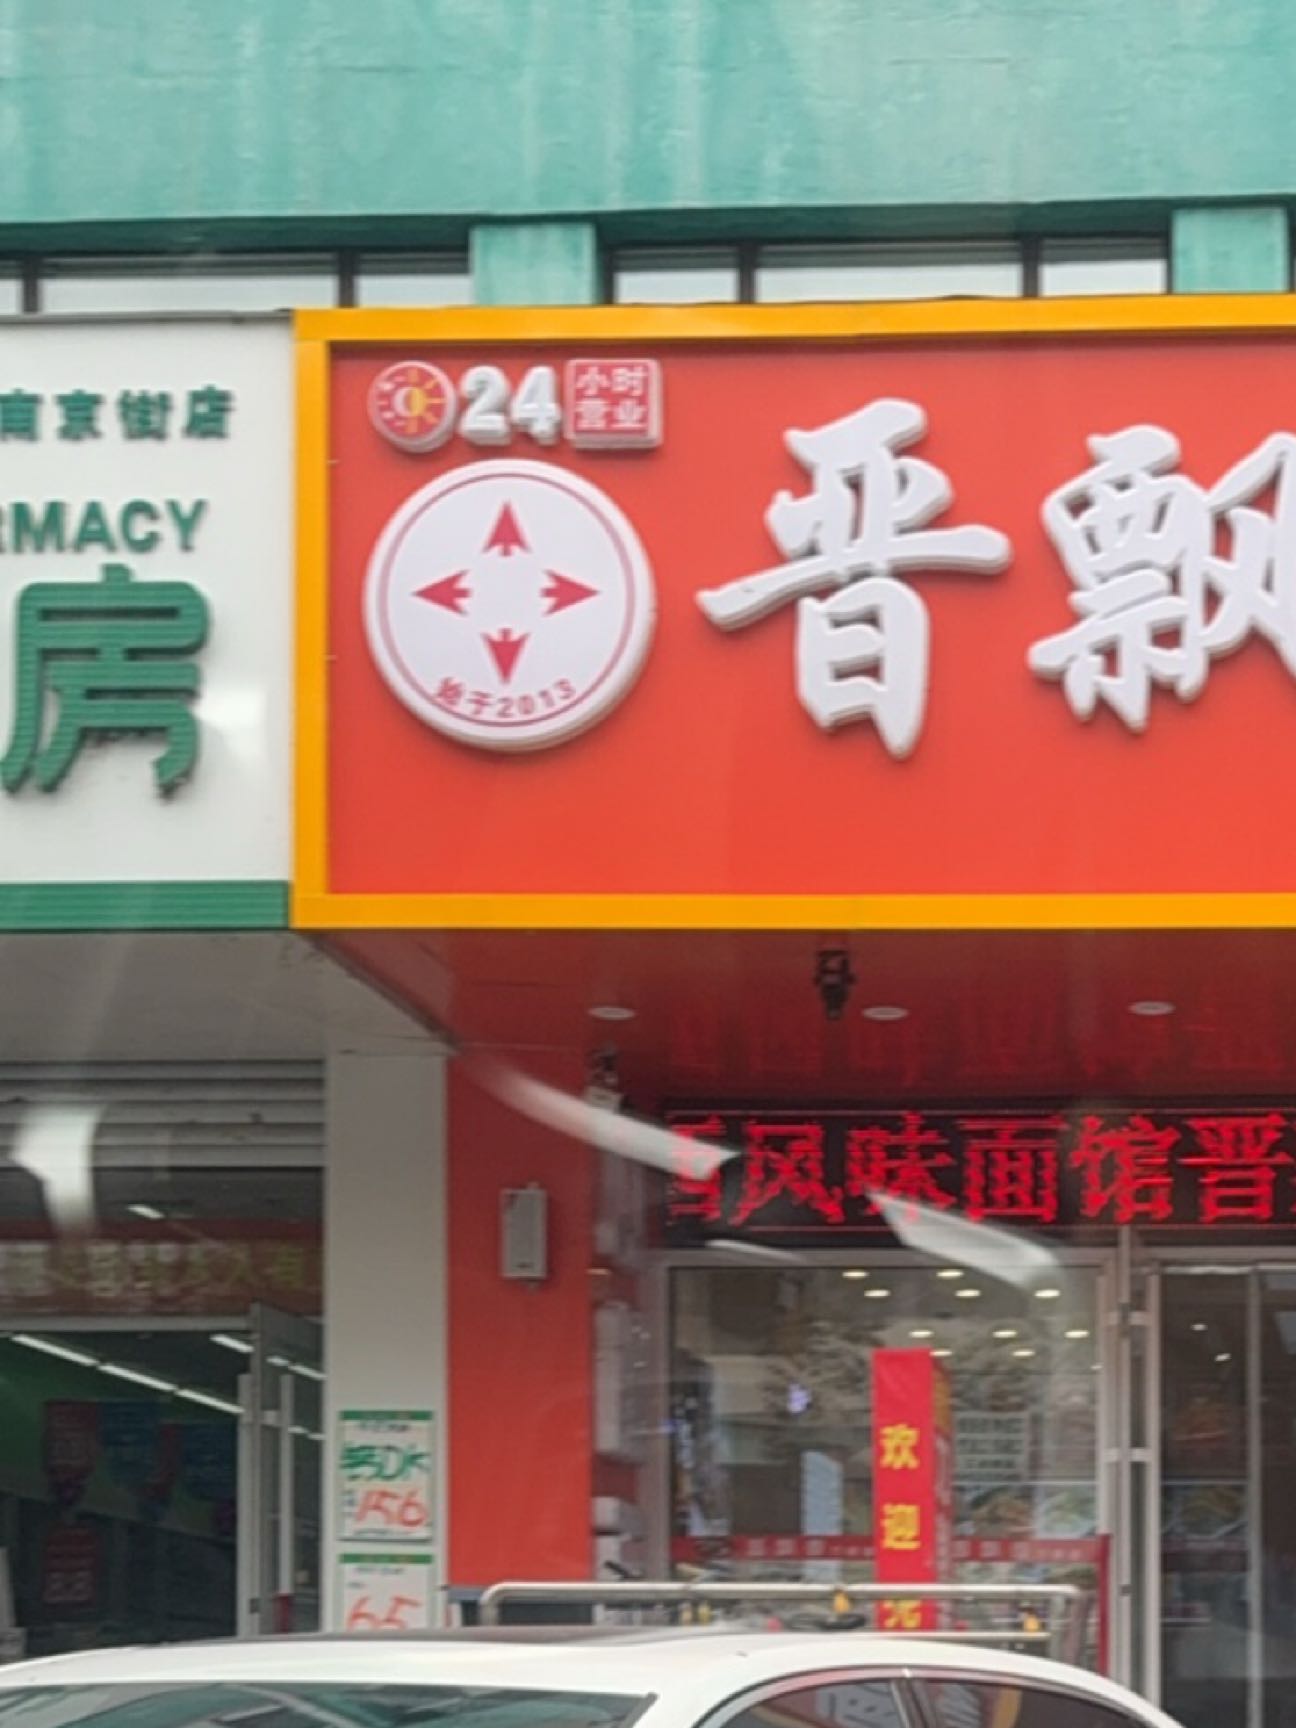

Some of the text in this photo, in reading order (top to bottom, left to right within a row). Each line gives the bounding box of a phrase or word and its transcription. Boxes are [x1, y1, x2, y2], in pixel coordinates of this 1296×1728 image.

[458, 366, 562, 444] 24
[576, 367, 648, 396] 小时
[576, 400, 648, 428] 营业
[0, 499, 208, 553] MACY
[0, 563, 211, 798] 房
